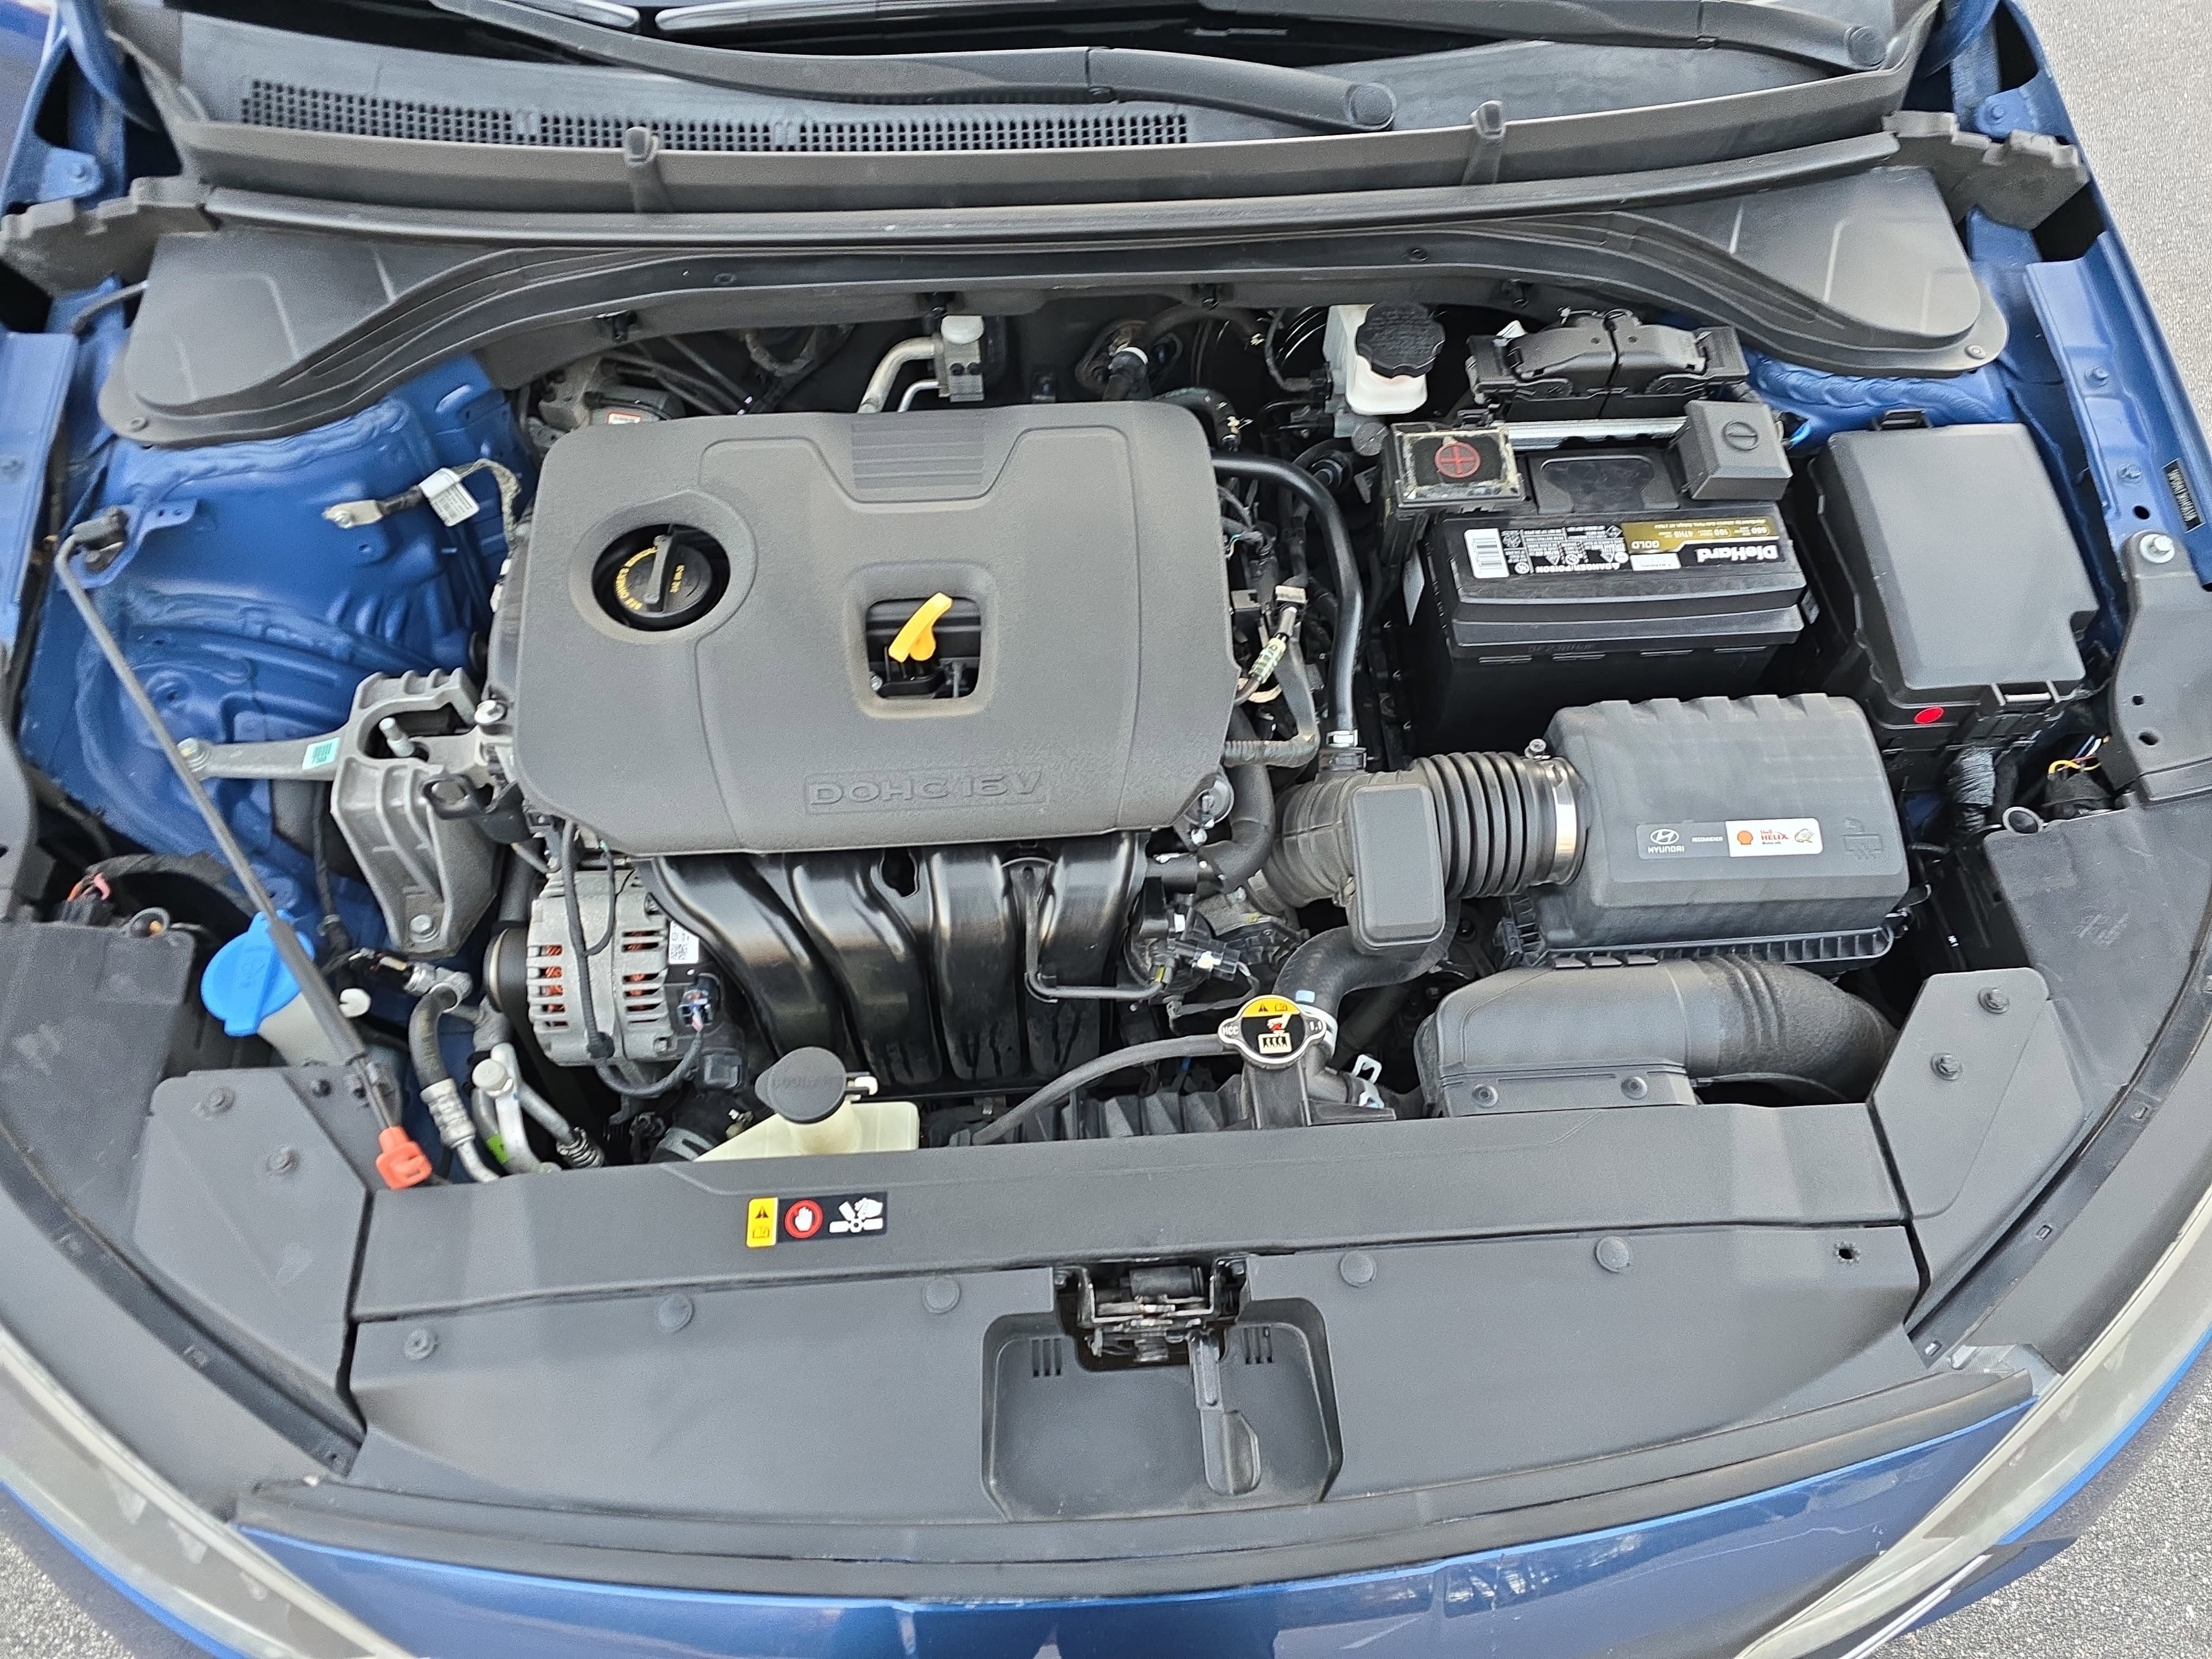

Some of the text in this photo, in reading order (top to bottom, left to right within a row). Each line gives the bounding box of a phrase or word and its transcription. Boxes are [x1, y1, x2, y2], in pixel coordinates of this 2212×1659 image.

[1631, 540, 1660, 549] GOLD
[1696, 545, 1779, 562] DieHard
[810, 779, 949, 806] DOHC
[1648, 845, 1684, 854] HYUNDAI
[1221, 1025, 1239, 1036] HCC
[1309, 1021, 1322, 1031] 1.1
